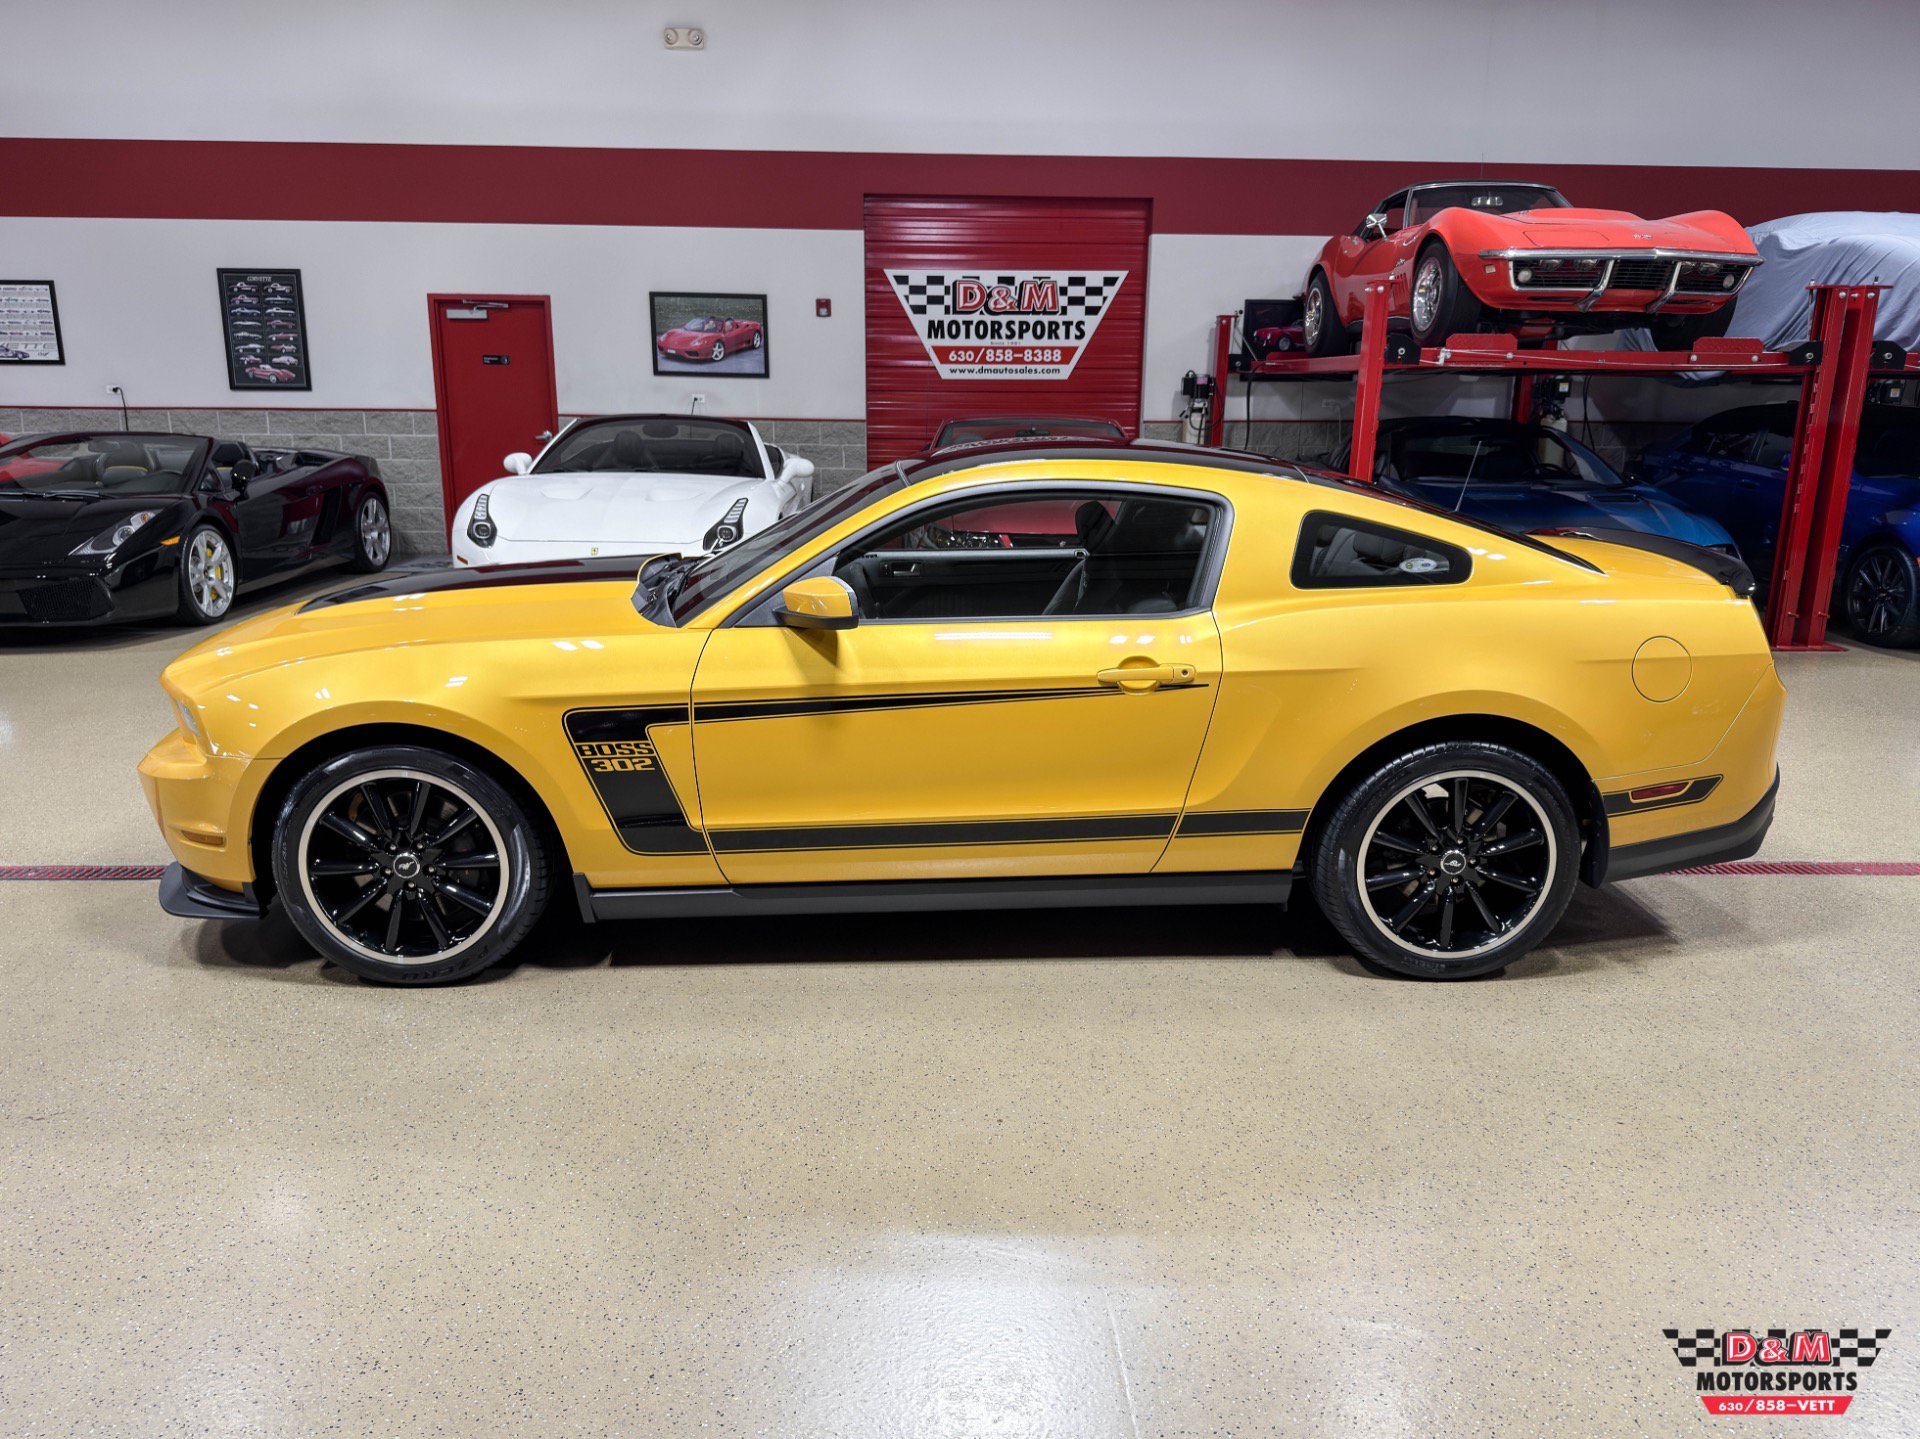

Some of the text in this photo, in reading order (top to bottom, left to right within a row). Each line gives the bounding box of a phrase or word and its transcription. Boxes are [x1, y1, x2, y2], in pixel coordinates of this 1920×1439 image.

[953, 280, 1060, 314] D&M
[927, 319, 1086, 341] MOTORSPORTS
[948, 348, 1062, 363] 630/858-8388
[949, 366, 1061, 375] www.dmautosales.com
[576, 743, 655, 756] BOSS
[590, 758, 655, 772] 302
